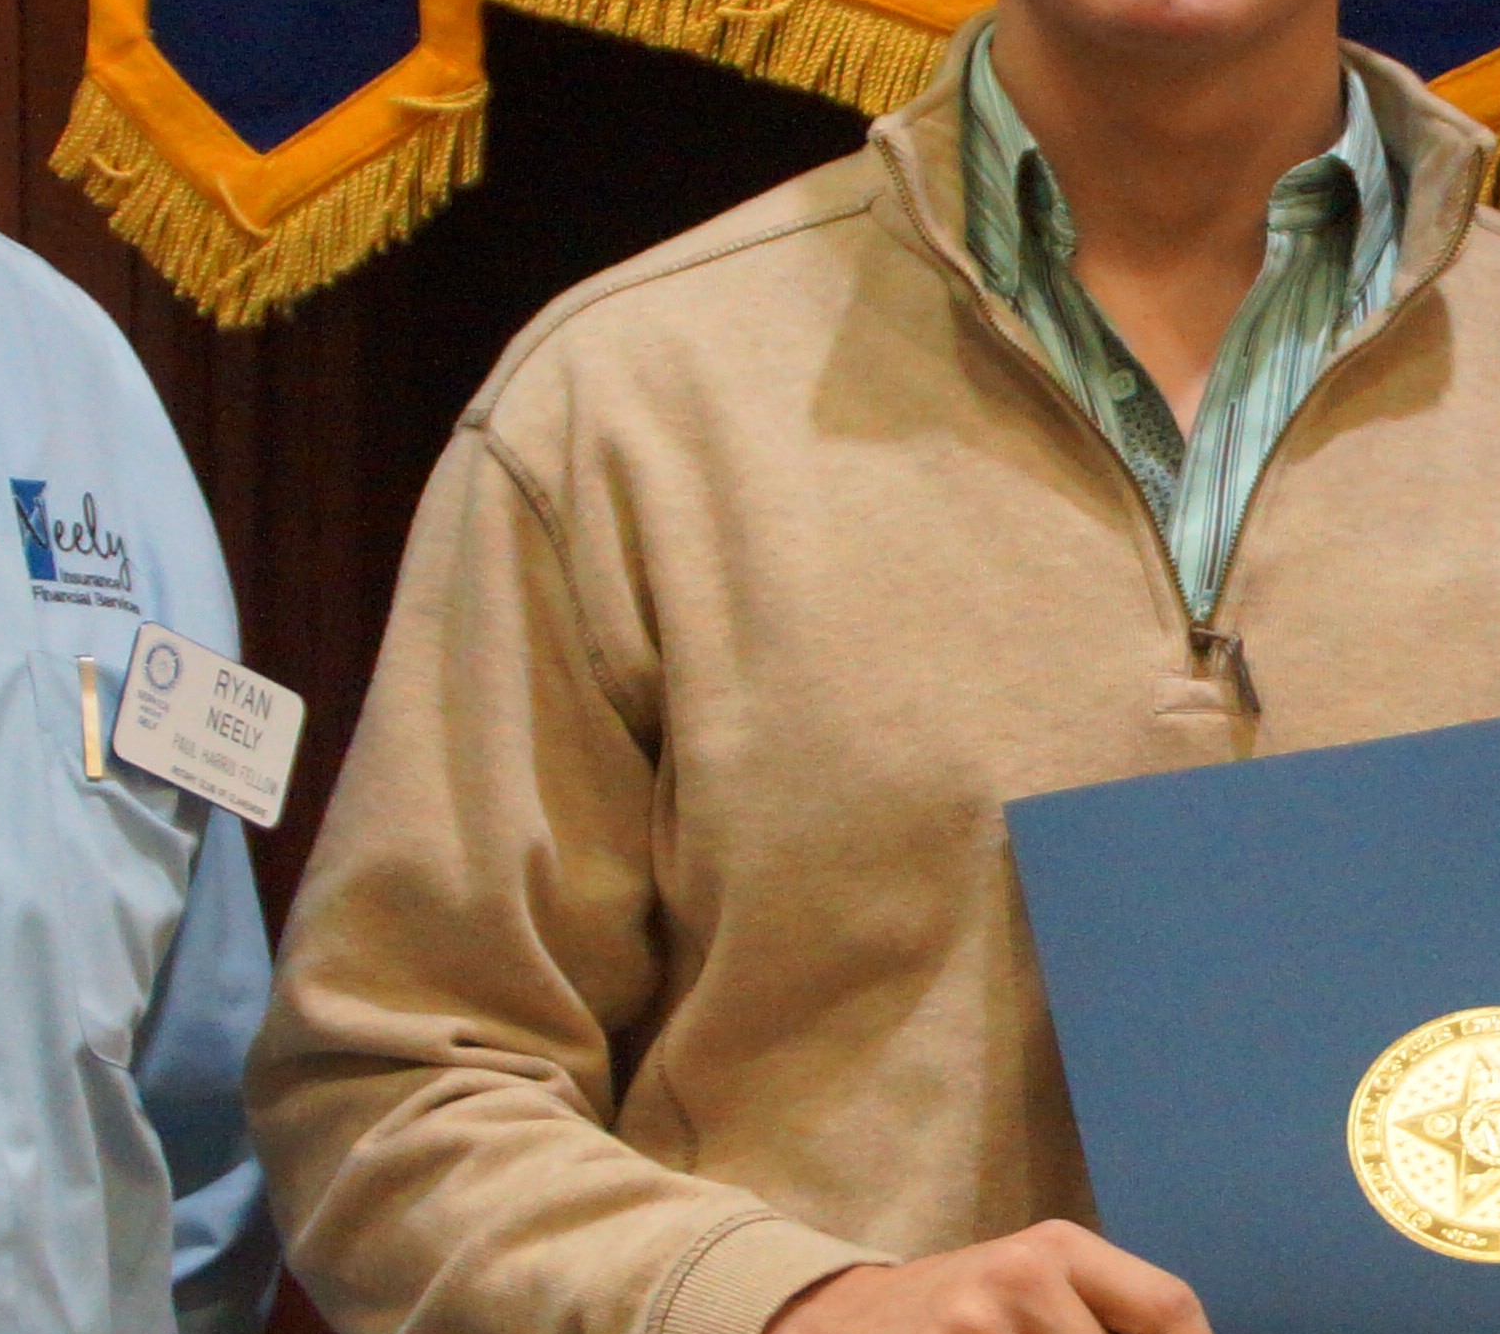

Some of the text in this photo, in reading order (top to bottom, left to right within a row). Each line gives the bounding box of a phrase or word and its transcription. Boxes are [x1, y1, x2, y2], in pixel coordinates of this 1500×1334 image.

[14, 490, 132, 592] Neely
[213, 668, 273, 720] RYAN
[205, 705, 264, 751] NEELY
